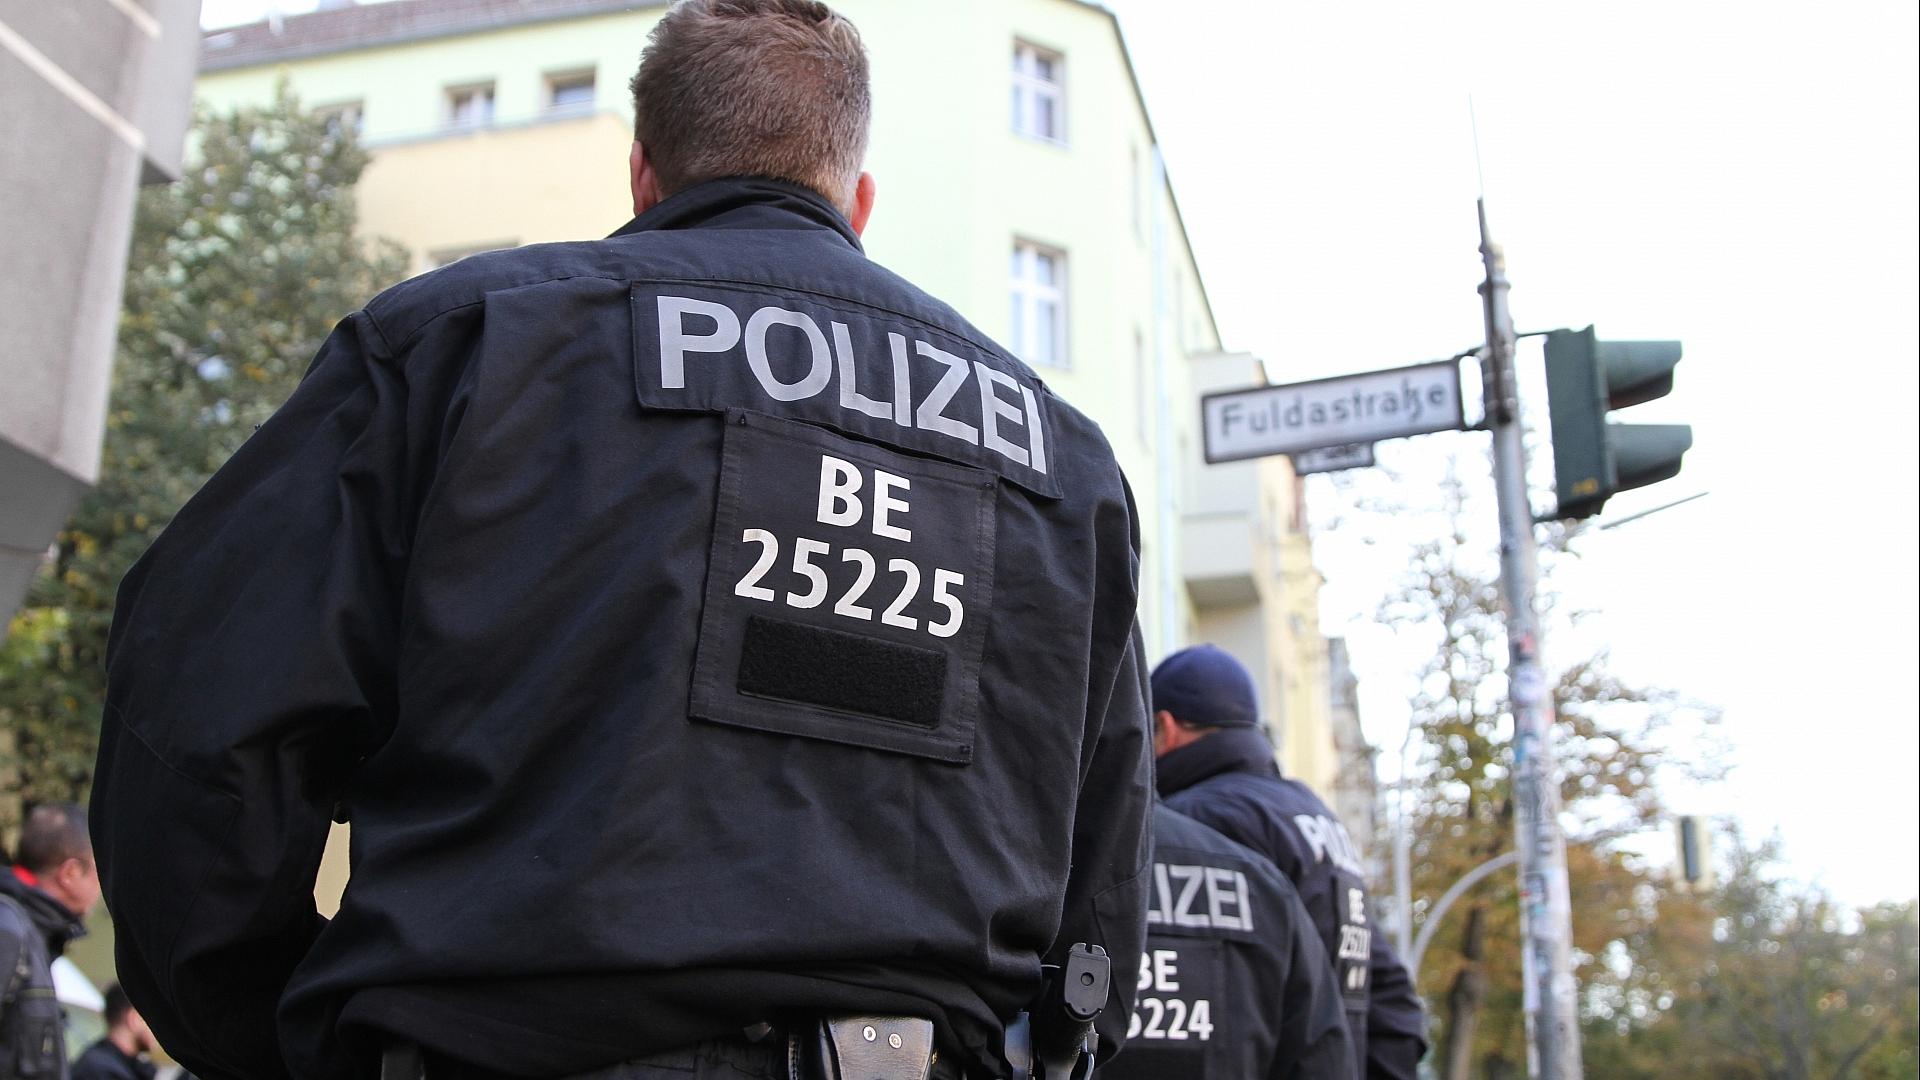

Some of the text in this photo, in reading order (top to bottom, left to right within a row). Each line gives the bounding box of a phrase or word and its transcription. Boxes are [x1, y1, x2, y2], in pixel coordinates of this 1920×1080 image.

[656, 295, 1047, 475] POLIZEI
[816, 454, 912, 543] BE
[734, 528, 965, 639] 25225
